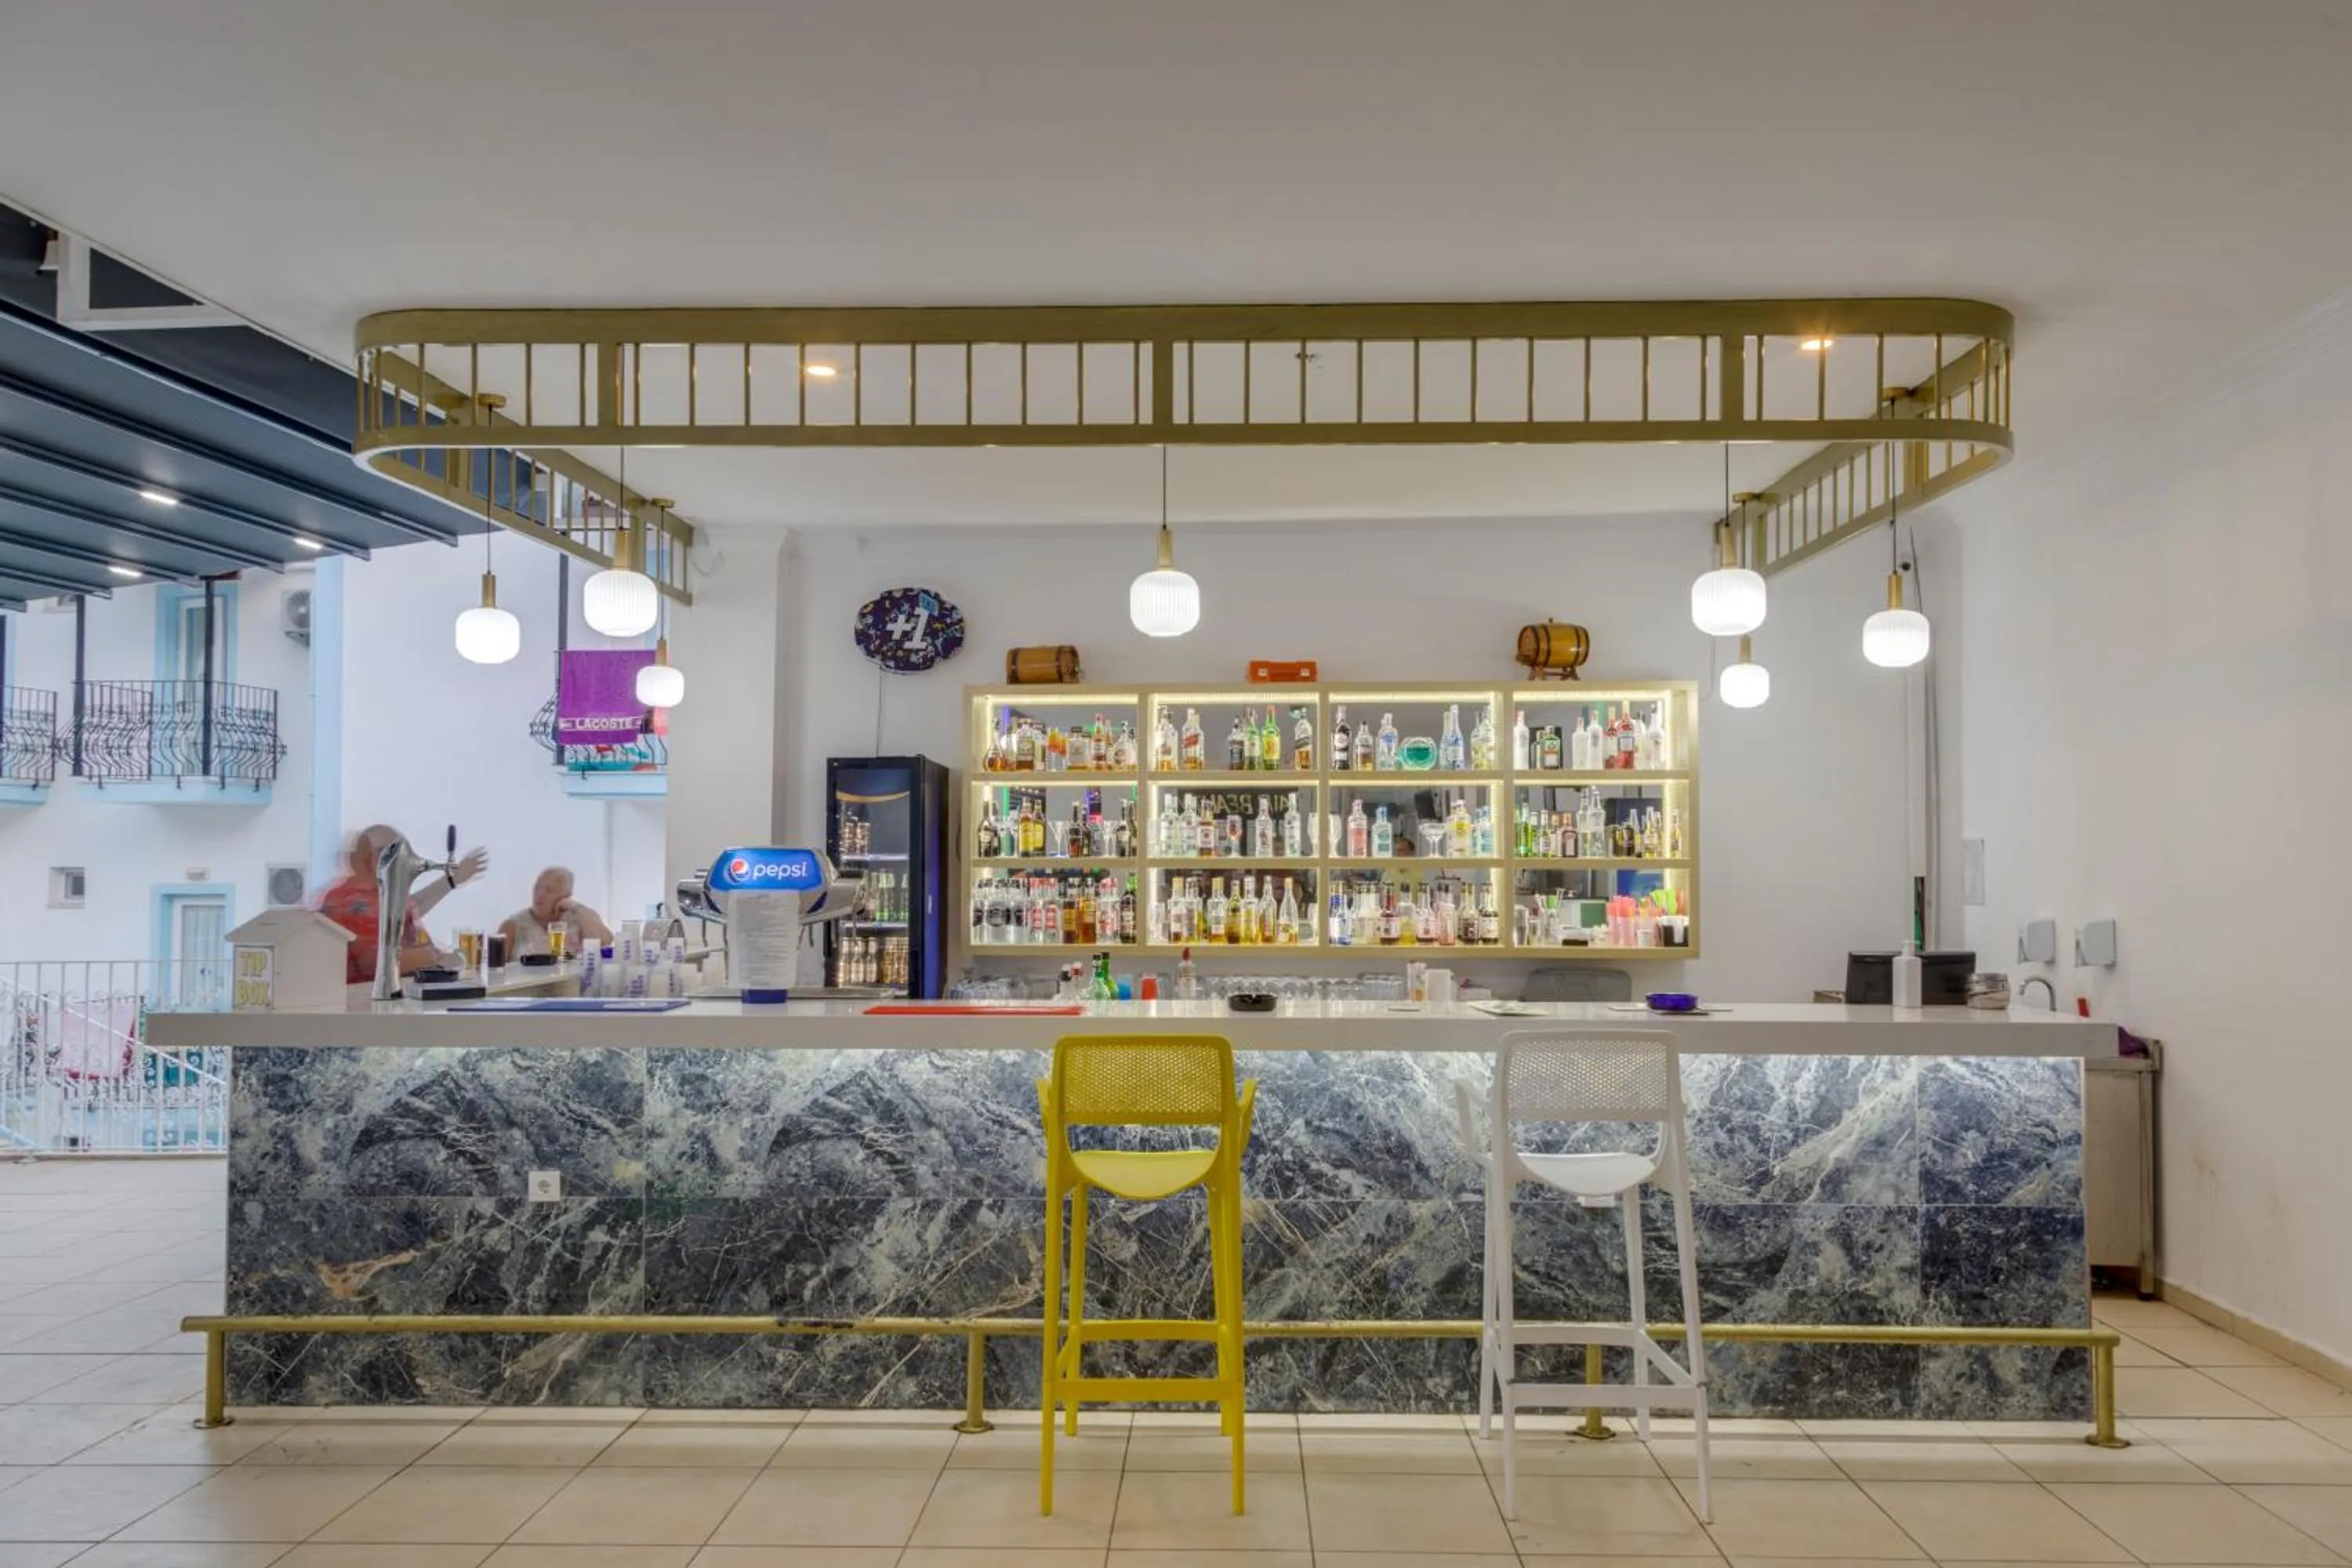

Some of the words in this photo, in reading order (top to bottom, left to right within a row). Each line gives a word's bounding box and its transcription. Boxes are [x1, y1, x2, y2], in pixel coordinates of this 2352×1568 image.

[576, 717, 631, 729] LACOSTE
[753, 862, 808, 880] pepsi
[240, 950, 267, 978] TIP
[237, 979, 270, 1007] BOX
